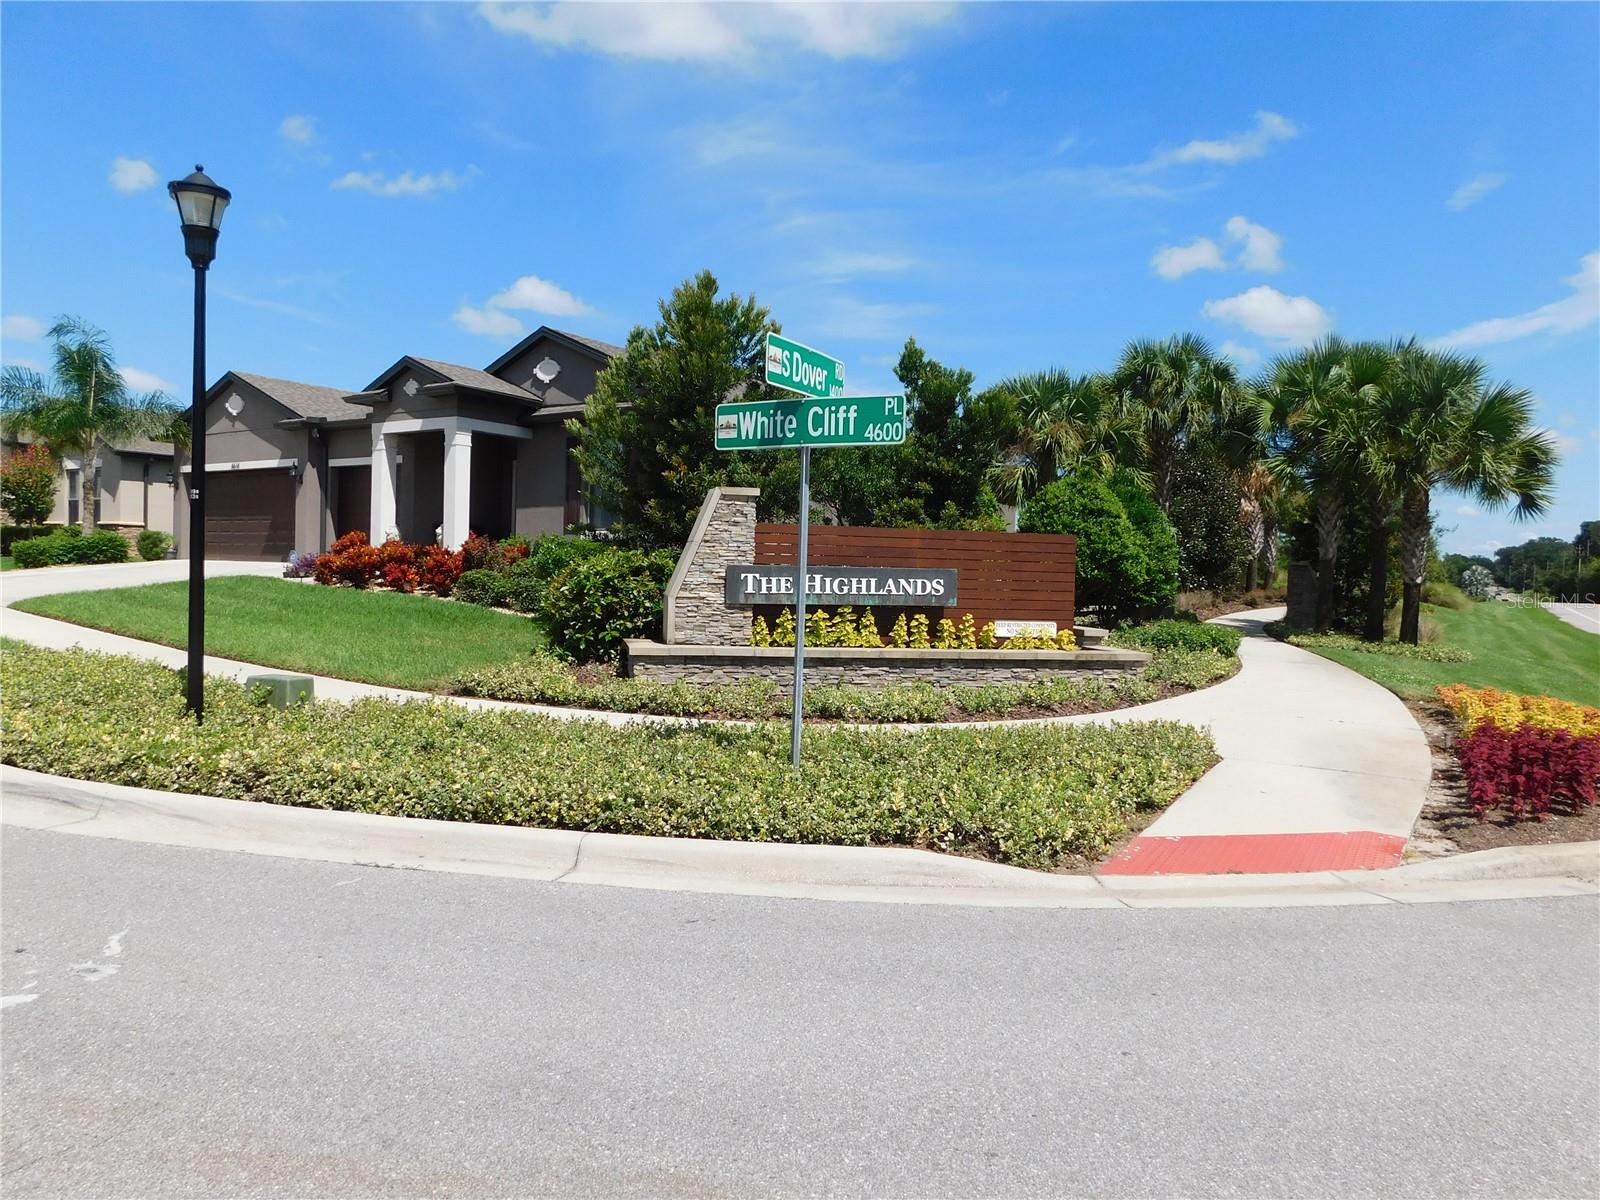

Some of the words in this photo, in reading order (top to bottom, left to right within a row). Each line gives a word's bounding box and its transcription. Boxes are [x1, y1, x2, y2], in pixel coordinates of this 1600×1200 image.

[782, 350, 791, 378] S
[793, 351, 828, 392] Dover
[835, 362, 844, 381] RD
[885, 397, 903, 416] PL
[739, 410, 797, 440] White
[807, 405, 858, 437] Cliff
[864, 422, 902, 442] 4600
[741, 573, 794, 595] THE
[805, 574, 945, 596] HIGHLANDS
